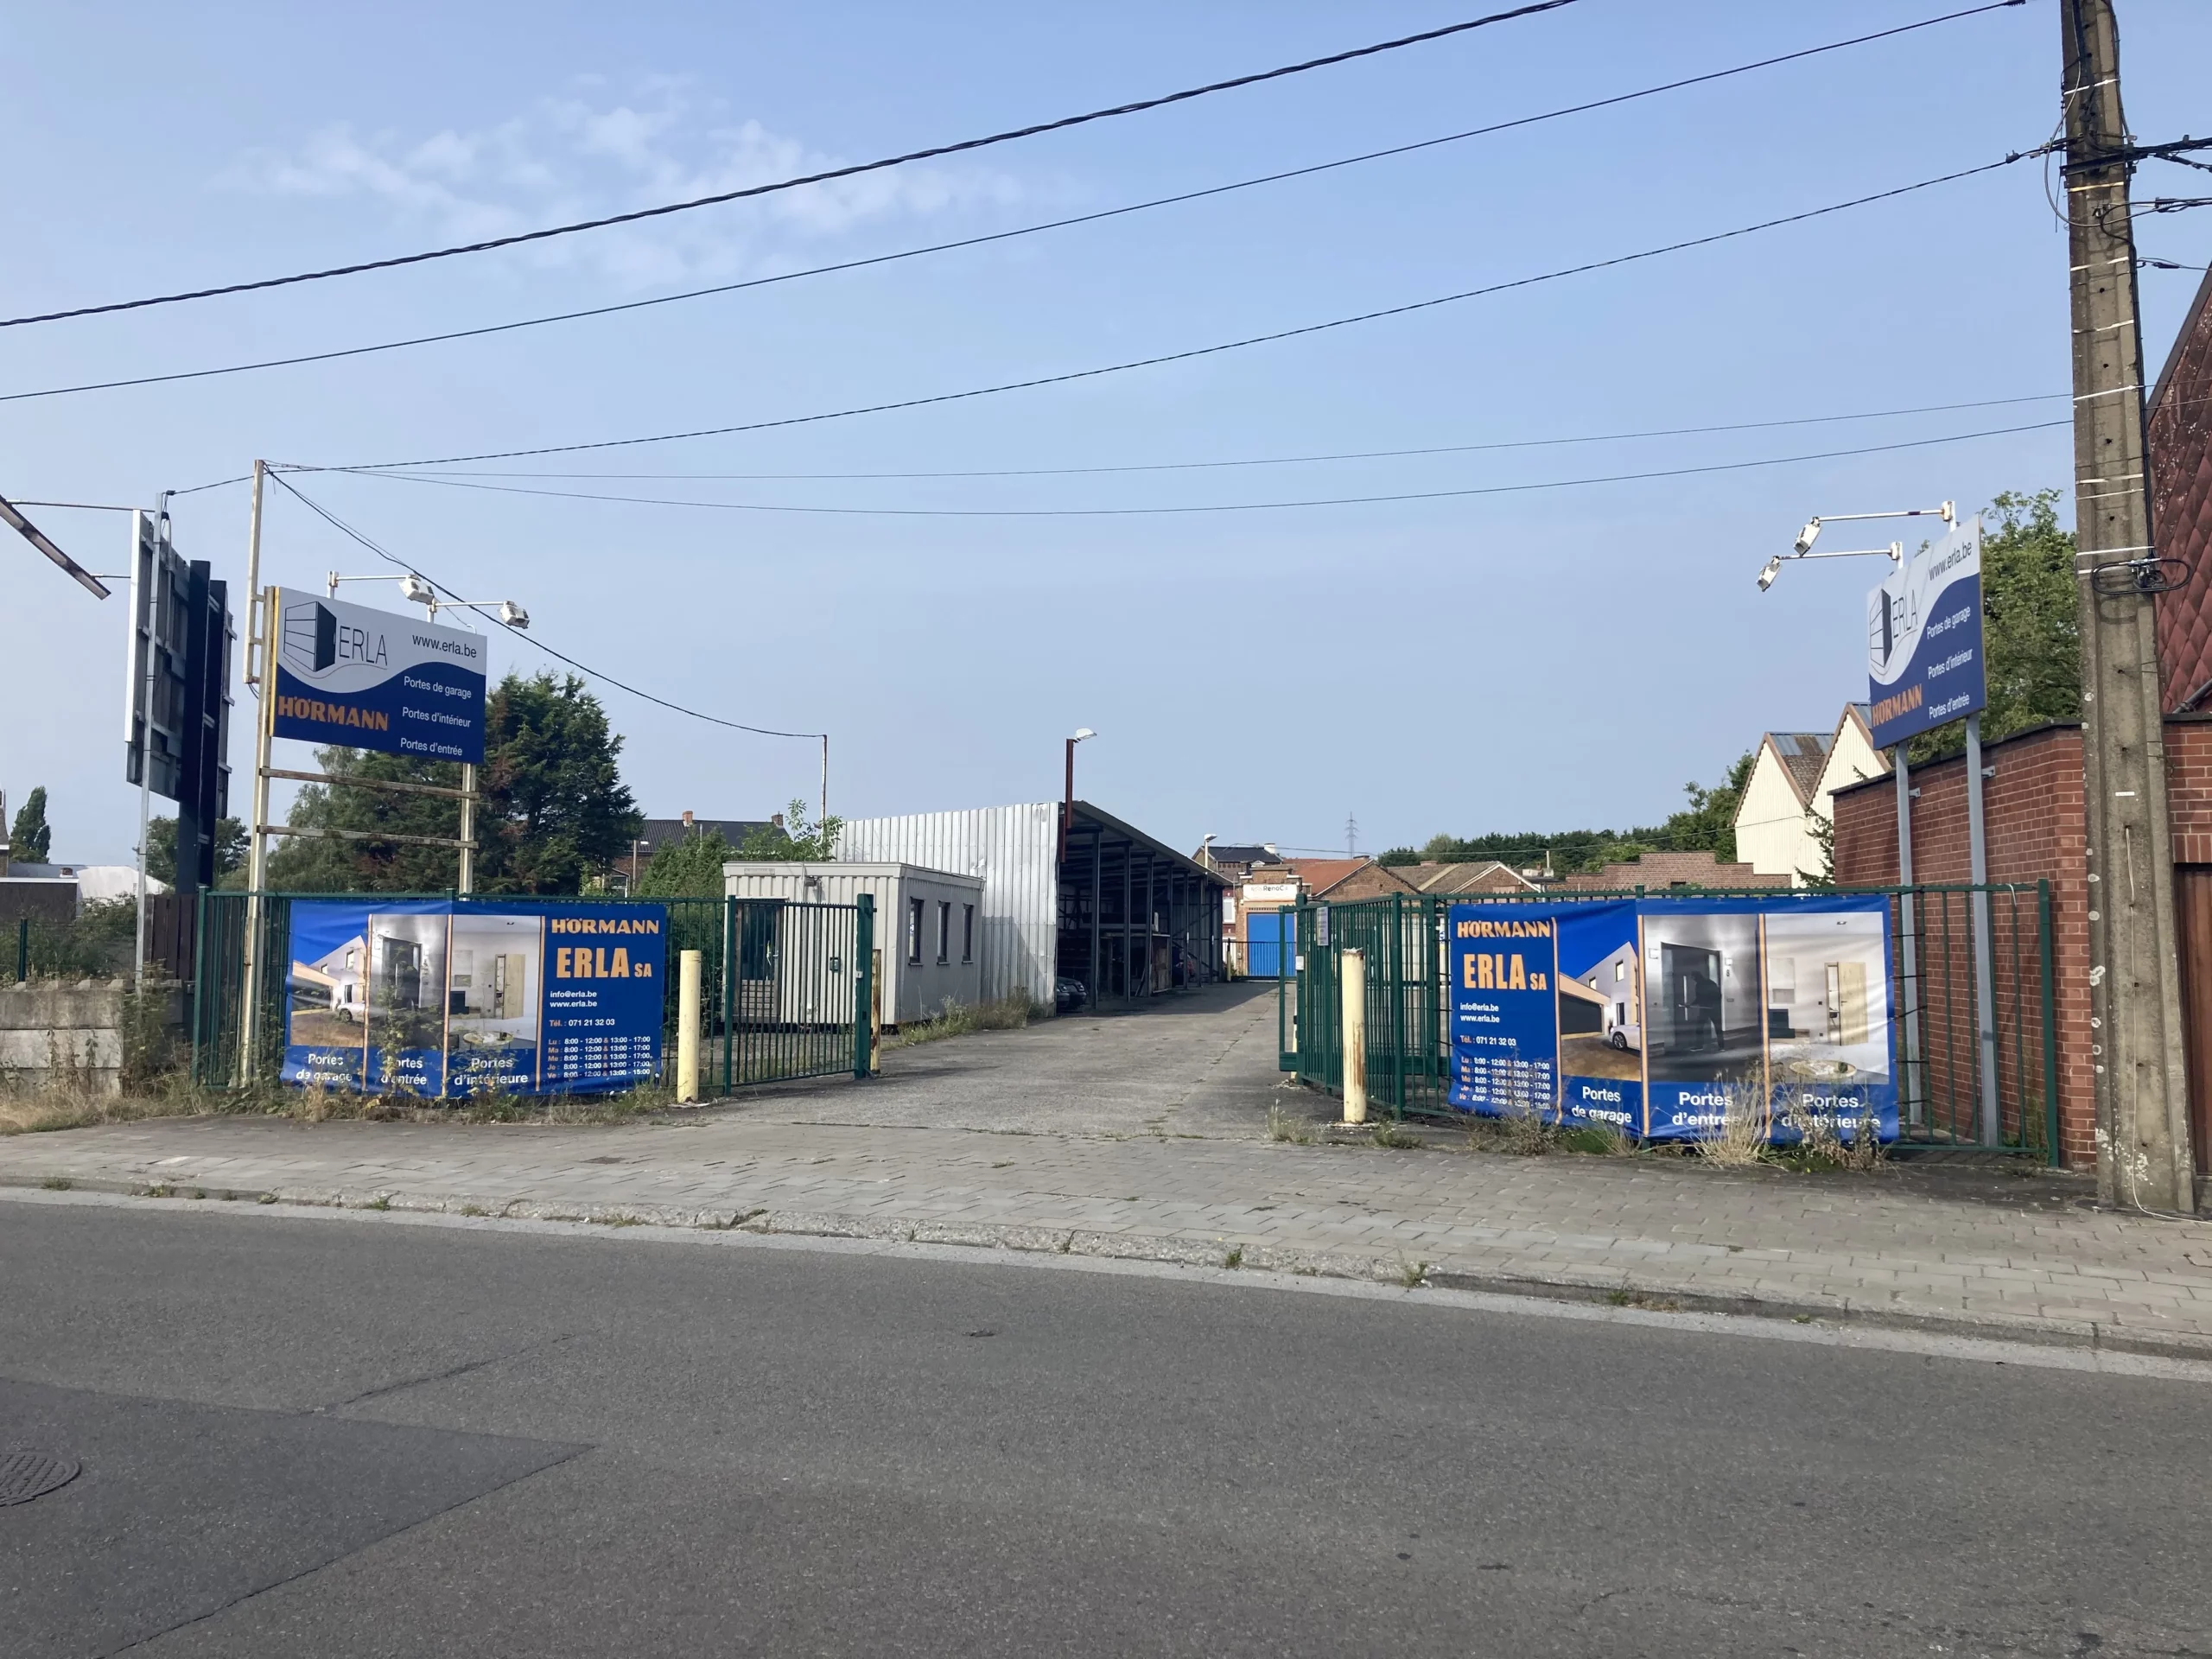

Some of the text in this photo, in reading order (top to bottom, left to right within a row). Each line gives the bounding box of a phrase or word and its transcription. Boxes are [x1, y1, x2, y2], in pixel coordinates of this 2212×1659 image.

[1929, 541, 1973, 581] www.erla.be
[1892, 589, 1918, 639] ERLA
[1927, 606, 1971, 639] Portes de garage
[339, 626, 388, 666] ERLA
[412, 634, 477, 658] www.erla.be
[1928, 648, 1973, 679] Portes d'intérieur
[404, 676, 472, 700] Portes de garage
[1929, 691, 1970, 720] Portes d'entrée
[402, 707, 472, 728] Portes d'intérieur
[400, 737, 463, 756] Portes d'entrée
[556, 947, 652, 978] ERLA SA
[1463, 953, 1548, 991] ERLA SA
[1459, 1002, 1499, 1012] info@erla.be
[1460, 1014, 1500, 1023] www.erla.be
[1476, 1036, 1488, 1045] 071
[1508, 1038, 1516, 1046] 03
[308, 1053, 344, 1065] Portes
[388, 1056, 423, 1069] ortes
[471, 1058, 514, 1068] Portes
[1582, 1085, 1621, 1103] Portes
[1679, 1091, 1733, 1106] Portes
[1802, 1093, 1859, 1108] Portes
[1571, 1104, 1632, 1125] de garage
